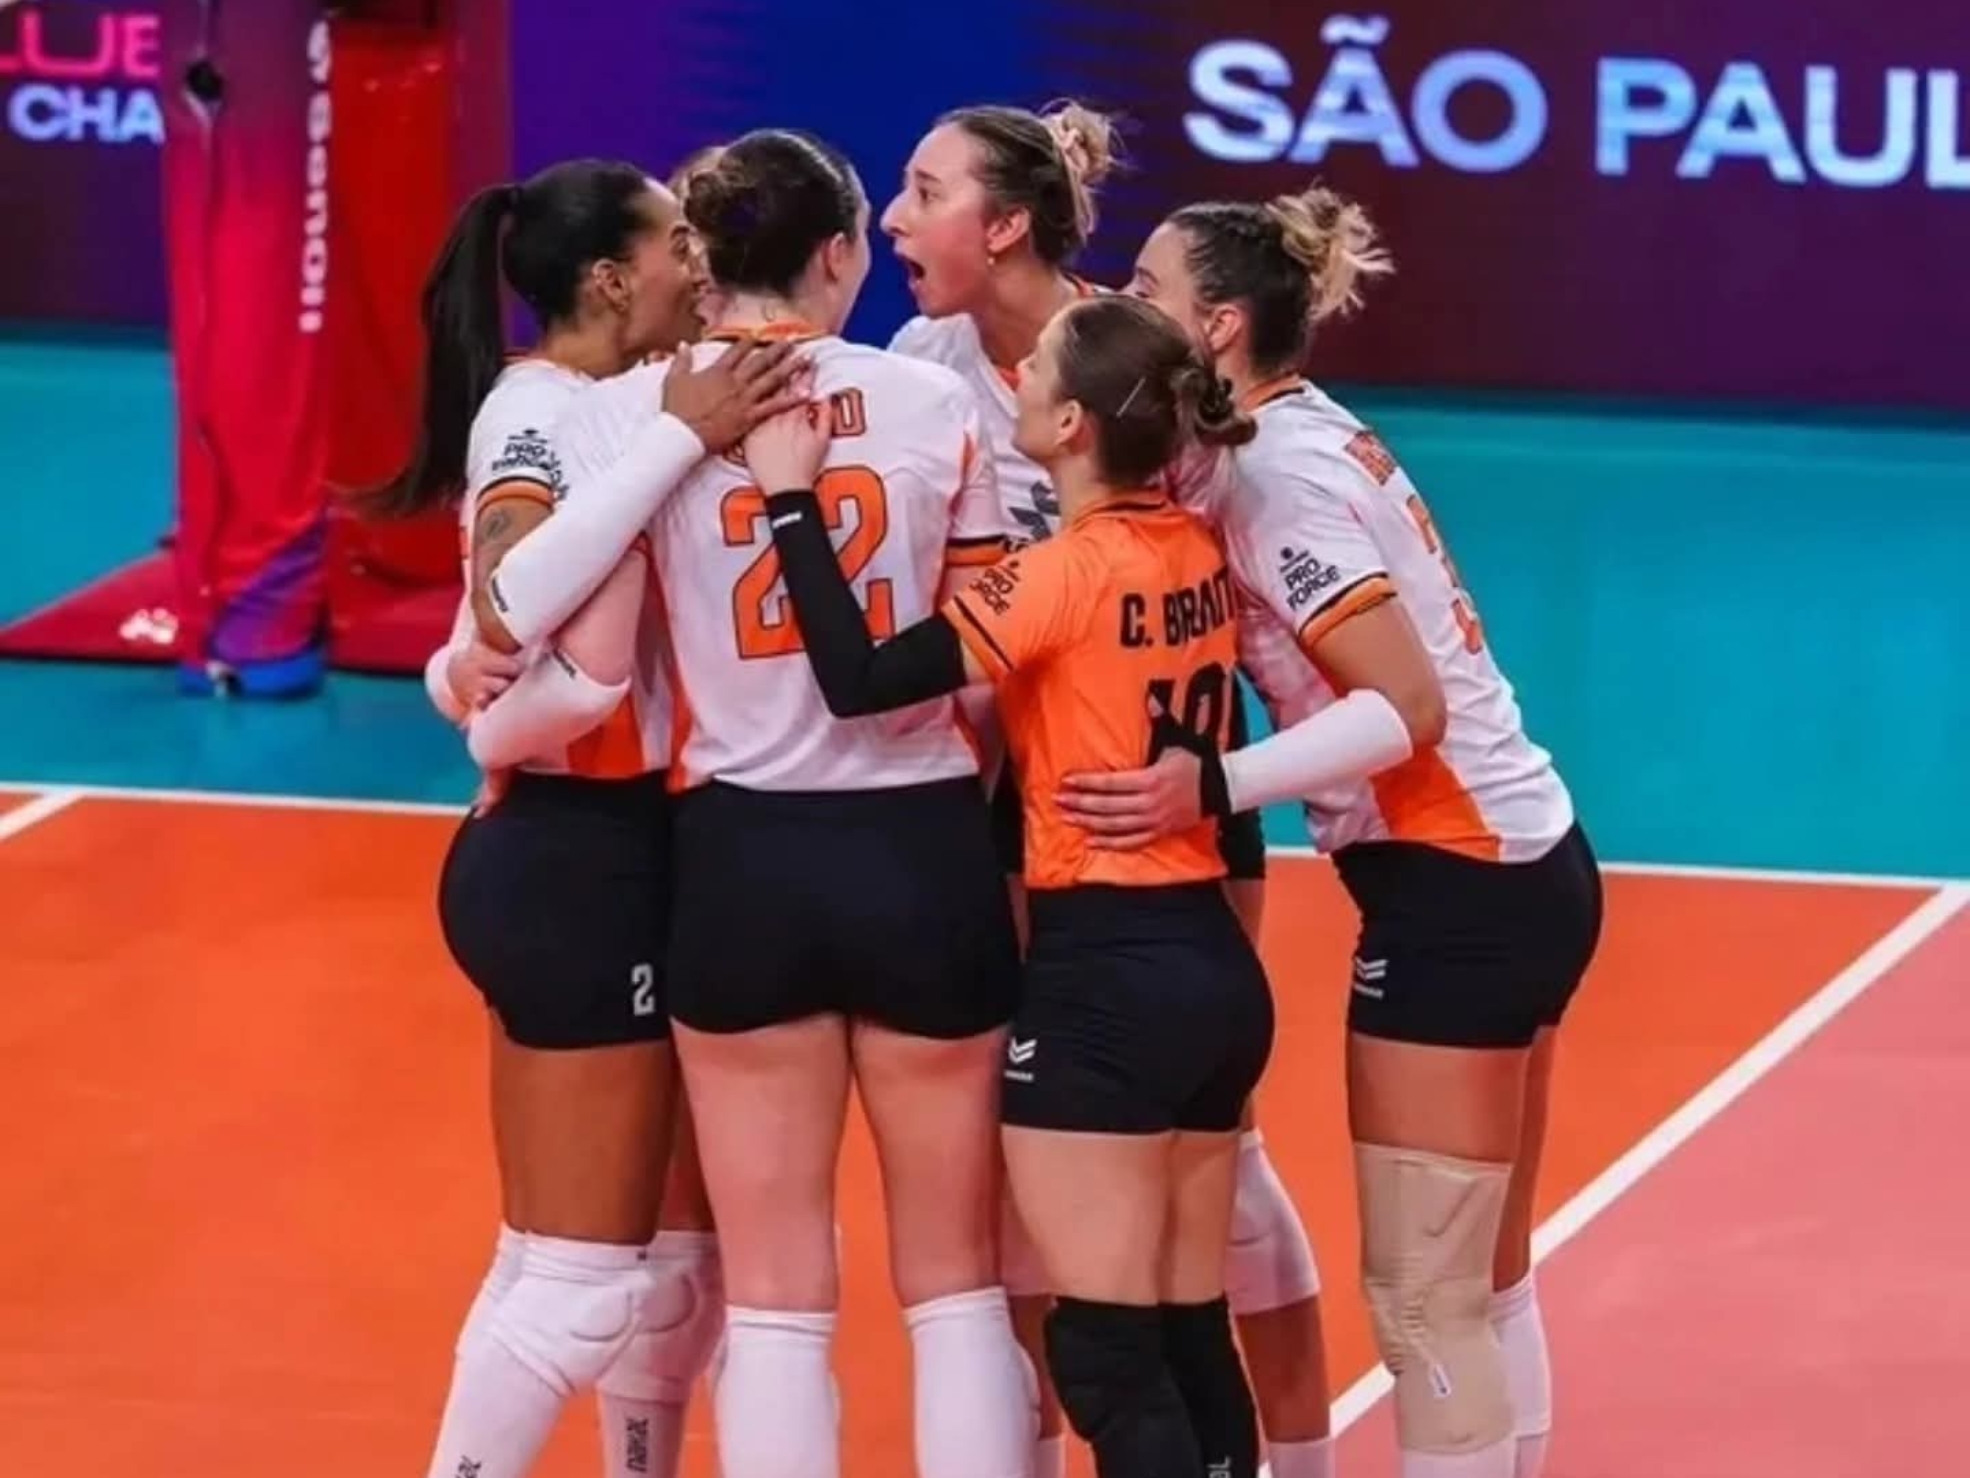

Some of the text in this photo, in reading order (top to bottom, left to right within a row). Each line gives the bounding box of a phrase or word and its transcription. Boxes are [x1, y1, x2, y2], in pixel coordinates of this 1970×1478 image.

[0, 11, 159, 78] UE
[9, 83, 166, 143] CHA
[1184, 15, 1970, 189] SÃO PAUL
[720, 464, 894, 660] 22
[1285, 558, 1321, 591] PRO
[1286, 564, 1341, 612] FORCE
[1121, 592, 1154, 647] C.
[631, 963, 656, 1016] 2
